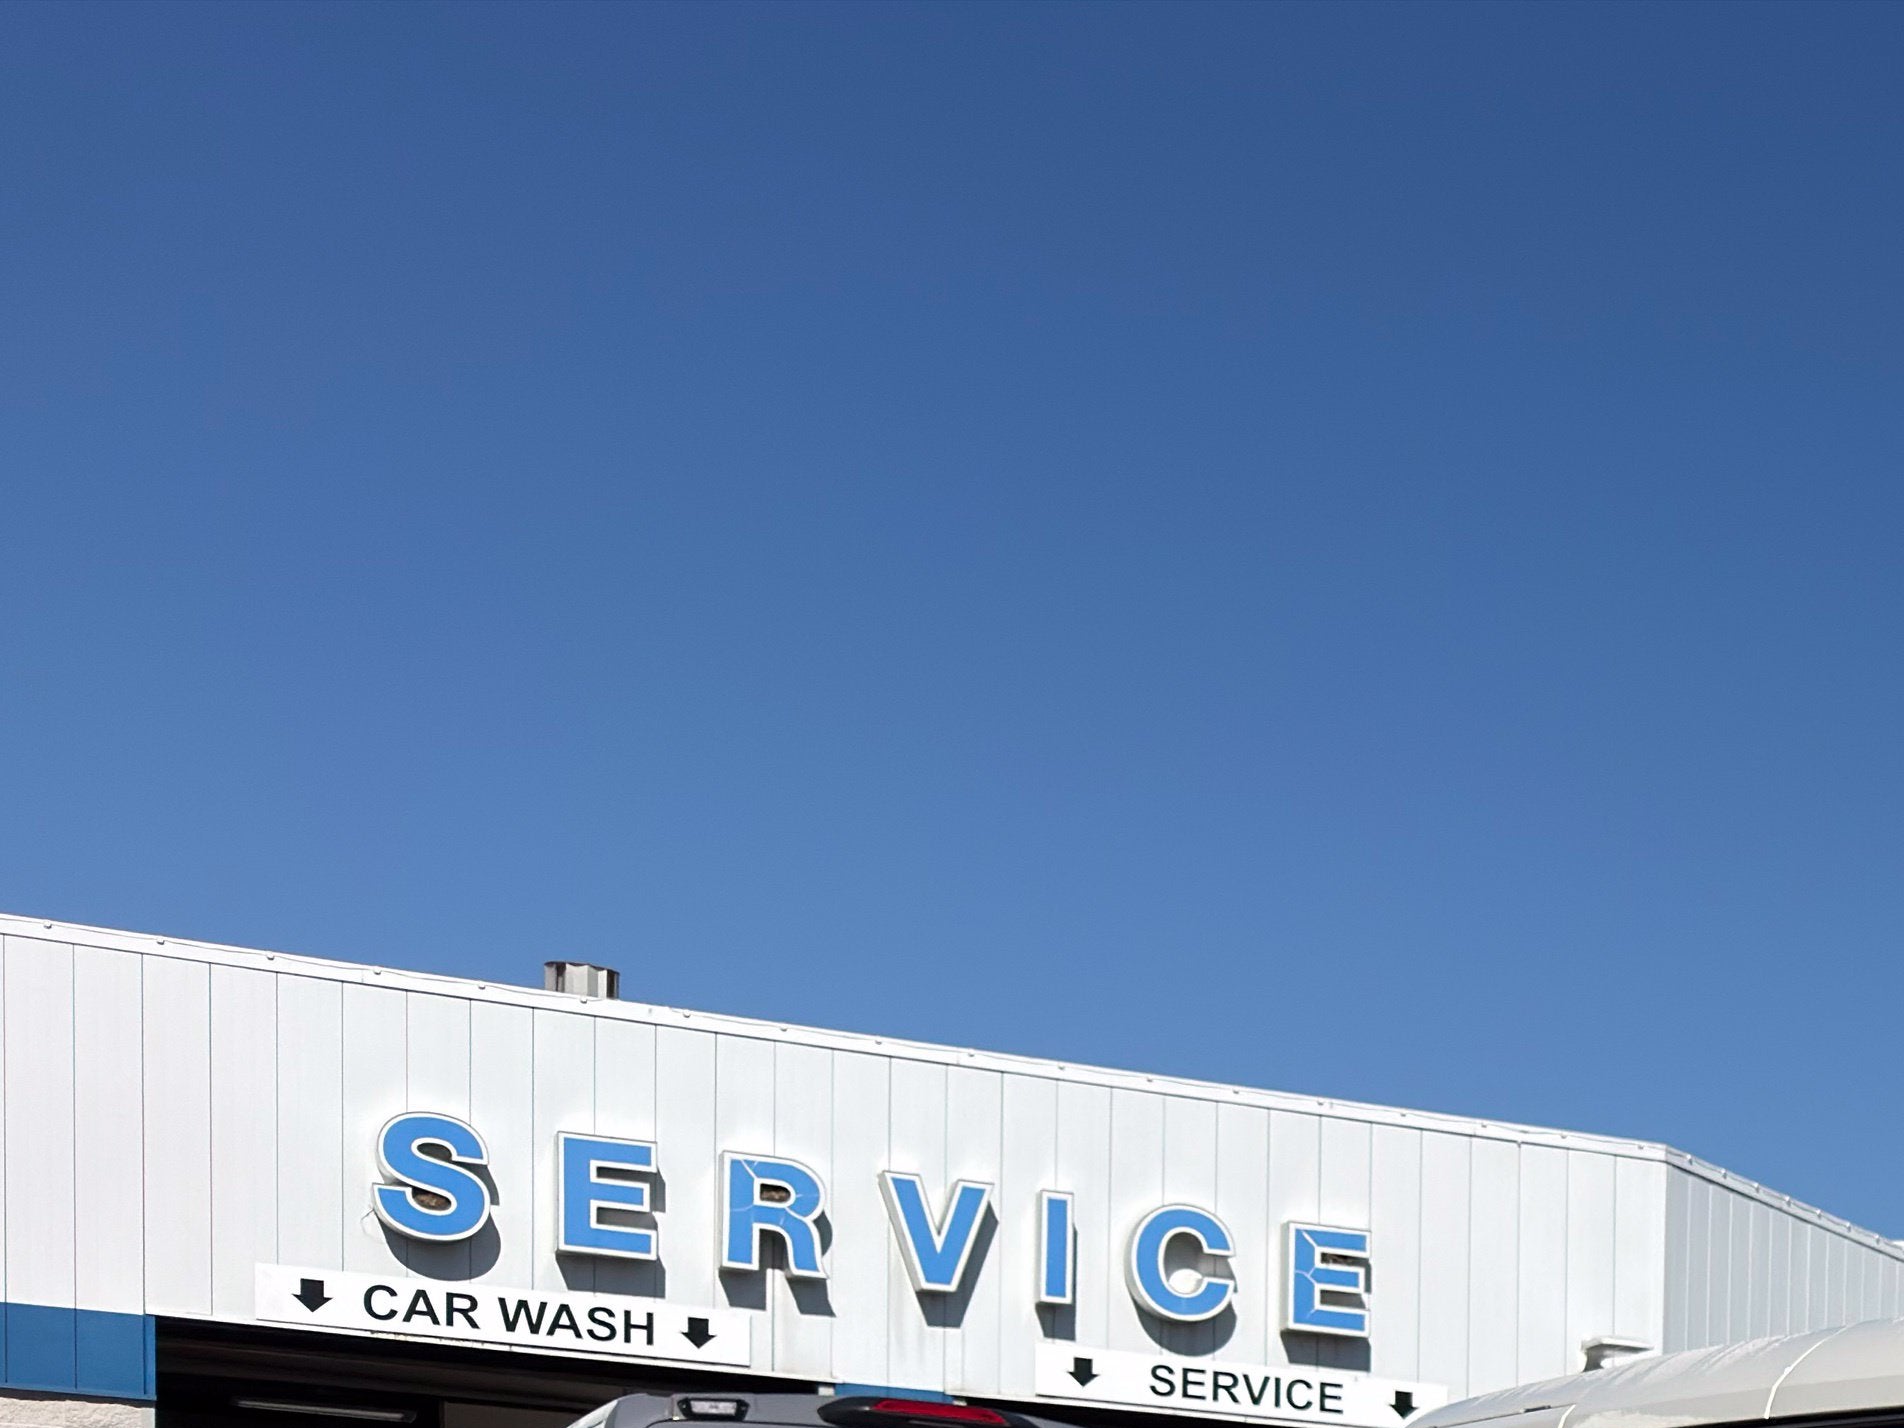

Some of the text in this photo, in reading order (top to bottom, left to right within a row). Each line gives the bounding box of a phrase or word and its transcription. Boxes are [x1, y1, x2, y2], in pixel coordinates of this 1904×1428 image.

[370, 1110, 1372, 1338] SERVICE
[361, 1282, 655, 1347] CAR WASH
[1148, 1364, 1346, 1415] SERVICE
